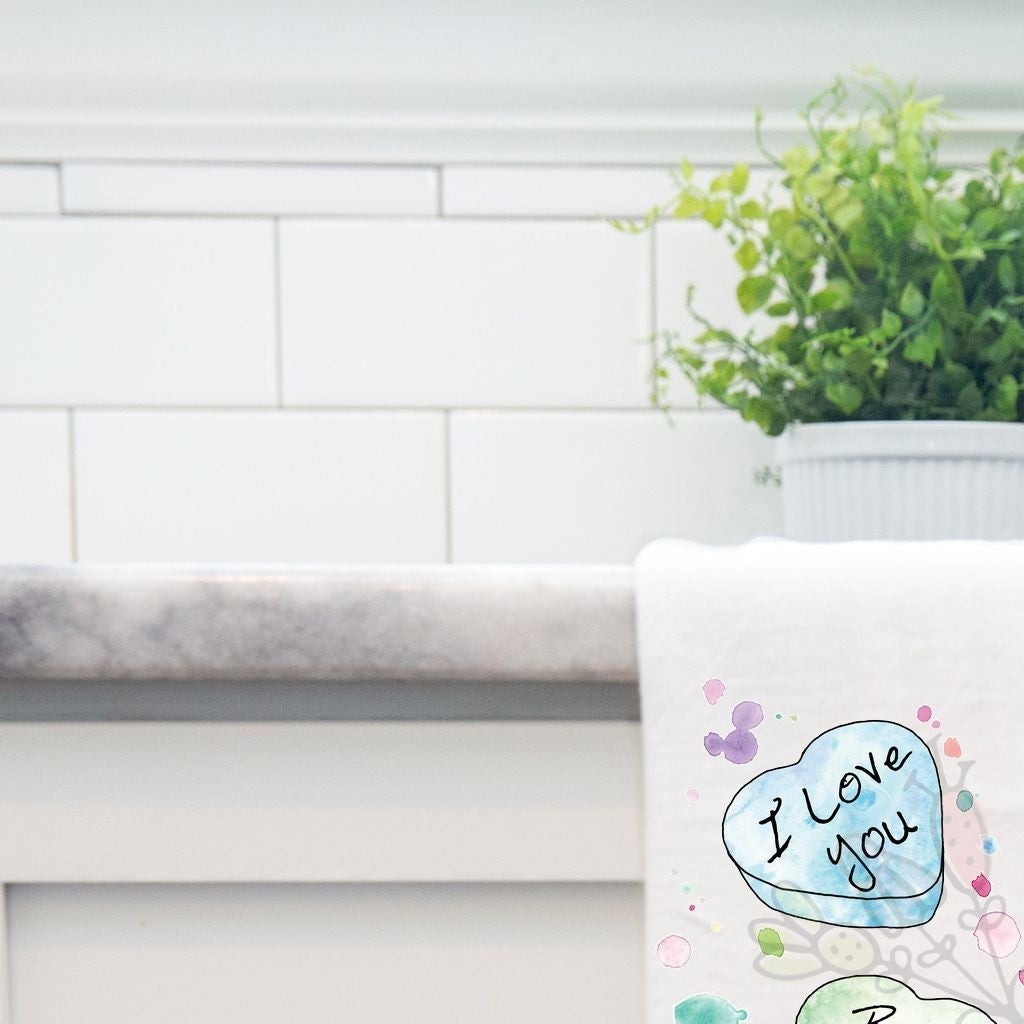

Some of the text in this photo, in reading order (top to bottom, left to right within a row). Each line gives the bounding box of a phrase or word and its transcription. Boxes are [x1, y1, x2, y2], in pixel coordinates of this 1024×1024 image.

[758, 745, 913, 864] I Love
[826, 811, 919, 893] you
